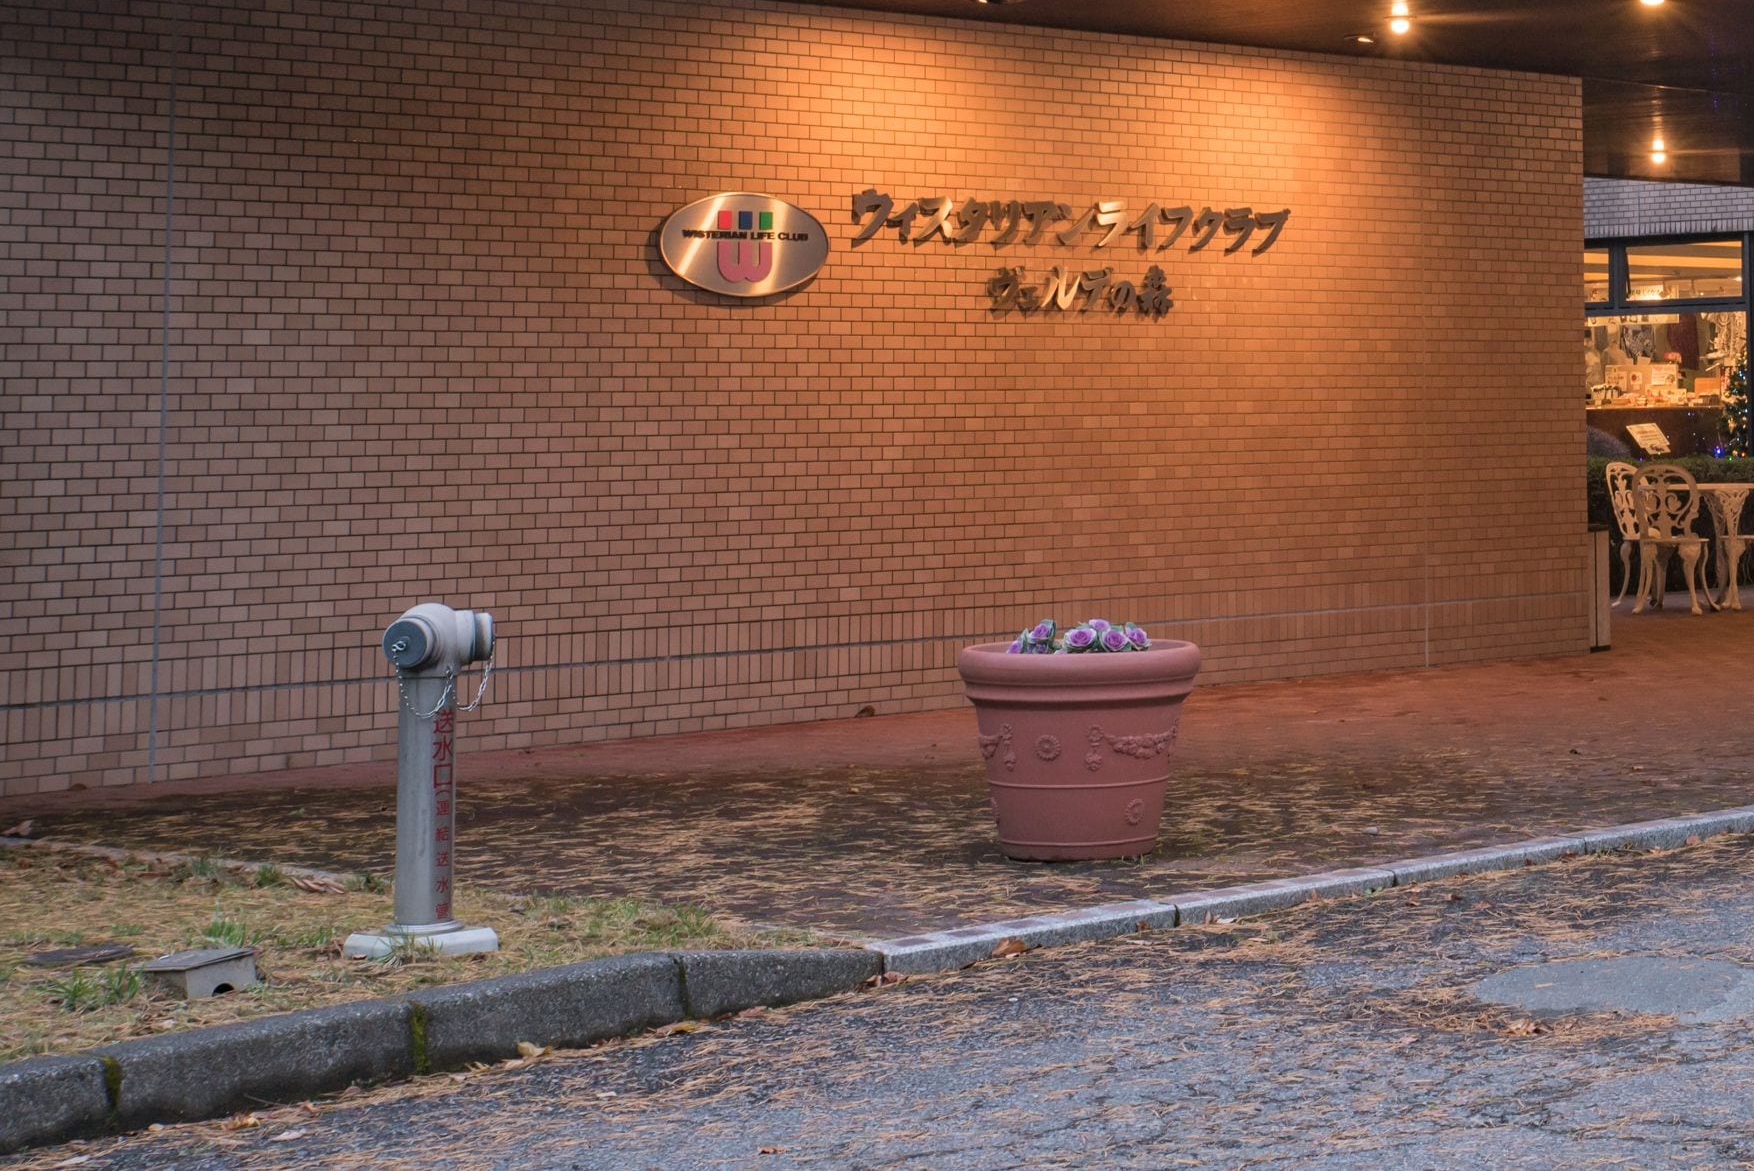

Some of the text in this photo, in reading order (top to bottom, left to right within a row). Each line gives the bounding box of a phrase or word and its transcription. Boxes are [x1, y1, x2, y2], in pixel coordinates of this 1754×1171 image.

[682, 229, 809, 242] WISTERIAN LIFE CLUB
[852, 189, 1291, 255] ウィスタリアンライフクラブ
[987, 264, 1175, 320] ヴェルデの森
